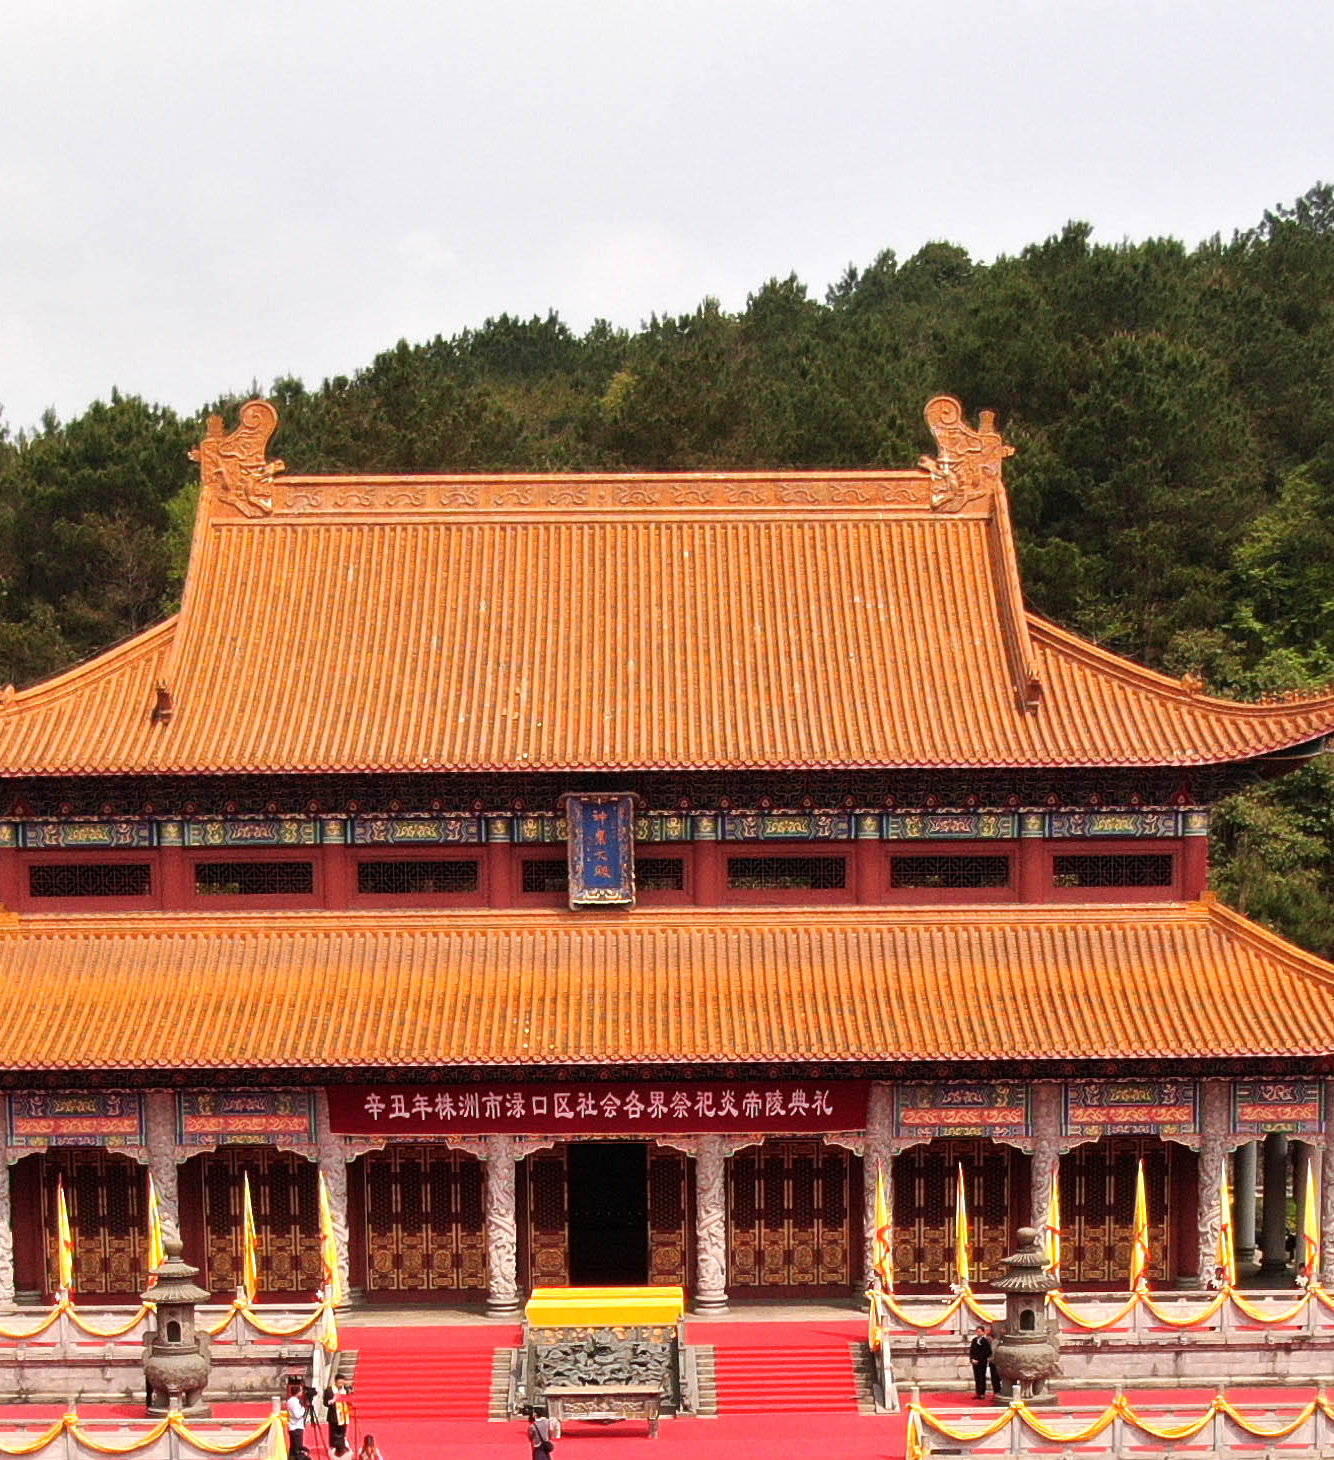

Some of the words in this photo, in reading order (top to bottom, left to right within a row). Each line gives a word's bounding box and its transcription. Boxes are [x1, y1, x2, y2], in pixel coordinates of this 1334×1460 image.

[364, 1089, 834, 1121] 辛丑年株洲市渌口区社会各界祭祀炎帝陵典礼
